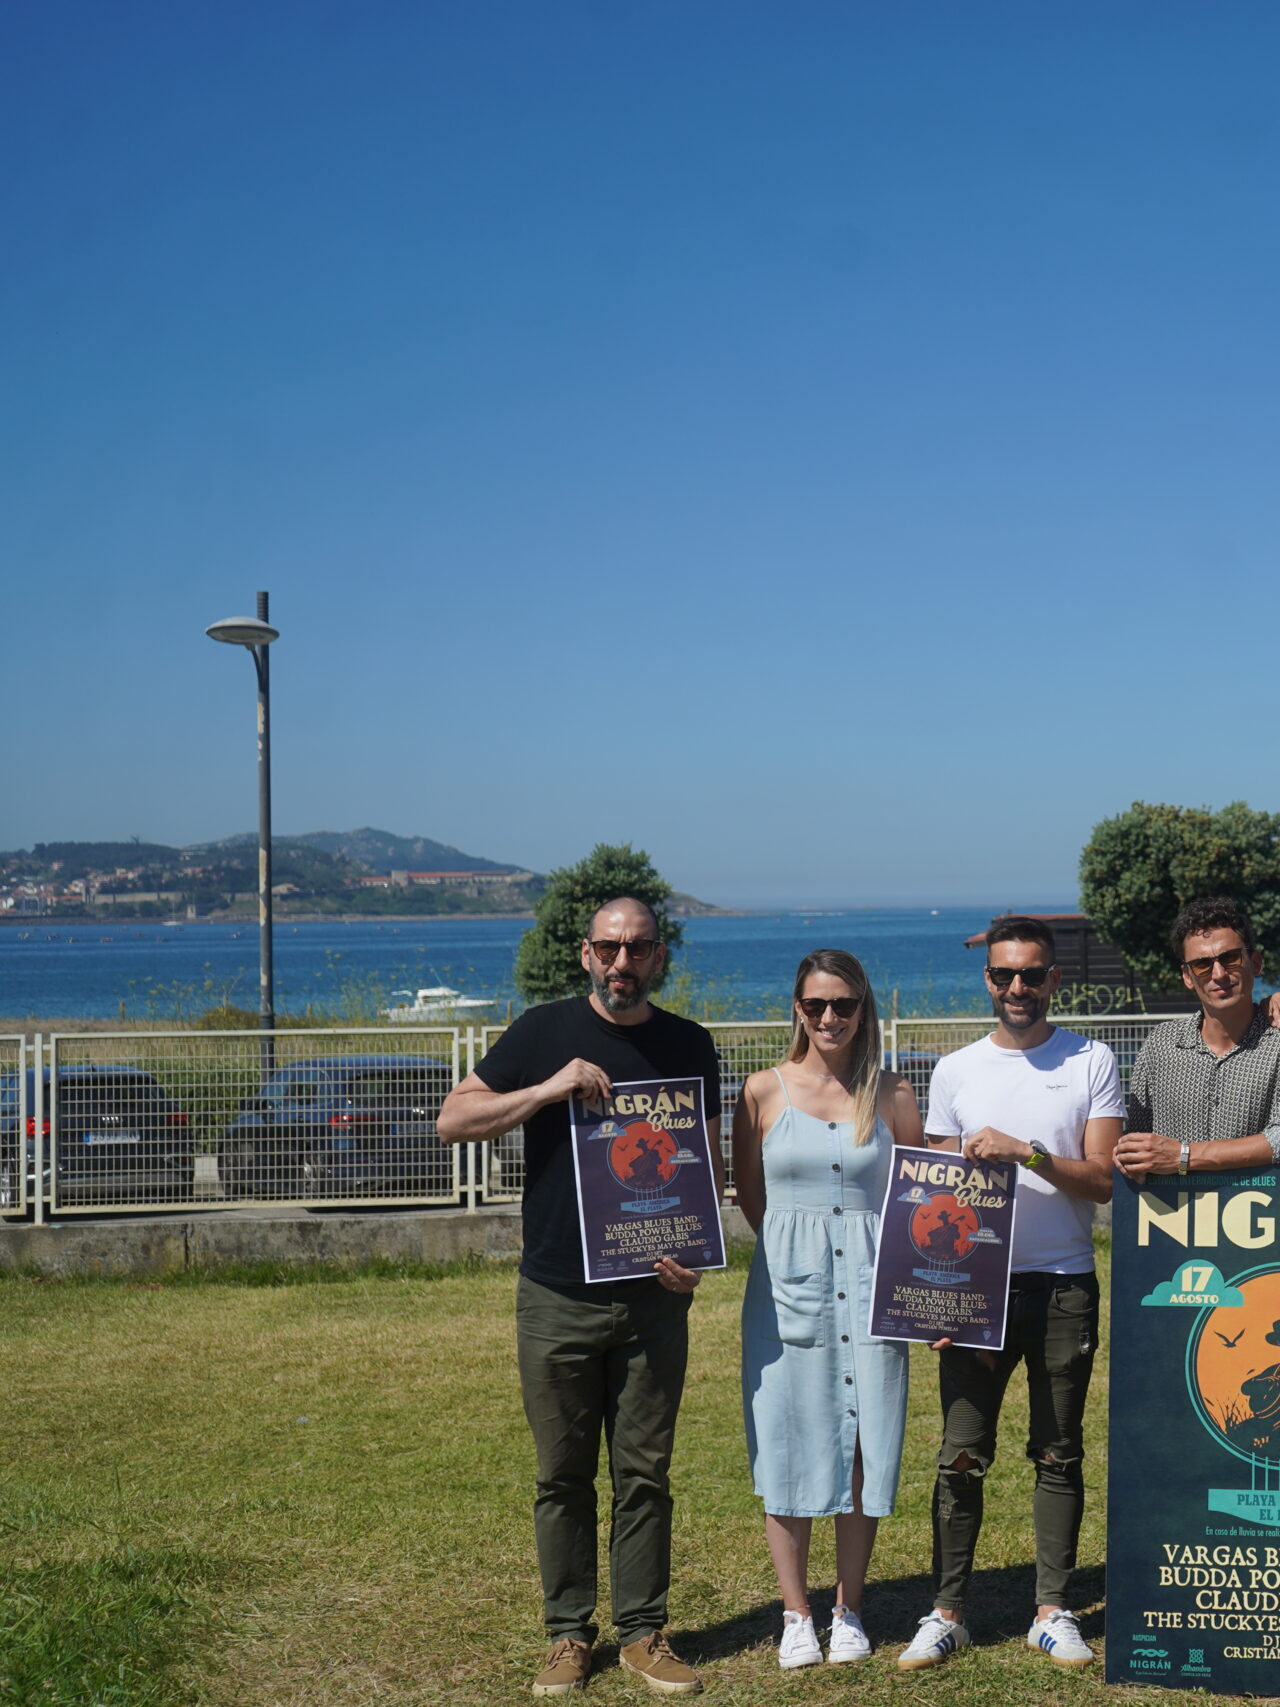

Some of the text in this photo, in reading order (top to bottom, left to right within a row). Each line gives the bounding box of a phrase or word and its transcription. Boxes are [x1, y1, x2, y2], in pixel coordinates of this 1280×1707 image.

[583, 1086, 694, 1118] NIGRÁN
[601, 1123, 614, 1132] 17
[646, 1111, 696, 1132] Blues
[1241, 1177, 1250, 1186] DE
[1252, 1176, 1276, 1186] BLUES
[953, 1185, 1006, 1208] Blues
[605, 1220, 642, 1232] VARGAS
[644, 1218, 671, 1227] BLUES
[674, 1215, 697, 1224] BAND
[605, 1223, 702, 1240] BUDDA POWER BLUES
[620, 1232, 689, 1247] CLAUDIO GABIS
[618, 1245, 655, 1254] STUCKYES
[657, 1242, 673, 1250] MAY
[1181, 1267, 1214, 1292] 17
[895, 1286, 929, 1296] VARGAS
[931, 1290, 958, 1299] BLUES
[960, 1293, 984, 1301] BAND
[1169, 1294, 1219, 1304] AGOSTO
[893, 1294, 987, 1309] BUDDA POWER BLUES
[902, 1311, 938, 1320] STUCKYES
[906, 1303, 972, 1316] CLAUDIO GABIS
[1237, 1494, 1276, 1506] PLAYA
[1259, 1509, 1273, 1520] EL
[1206, 1526, 1213, 1535] En
[1230, 1527, 1238, 1536] de
[1239, 1527, 1255, 1537] lluvia
[1163, 1544, 1258, 1566] VARGAS
[1159, 1566, 1242, 1588] BUDDA
[1144, 1611, 1183, 1628] THE
[1130, 1660, 1171, 1669] NIGRÁN
[1181, 1664, 1211, 1672] Alhambra
